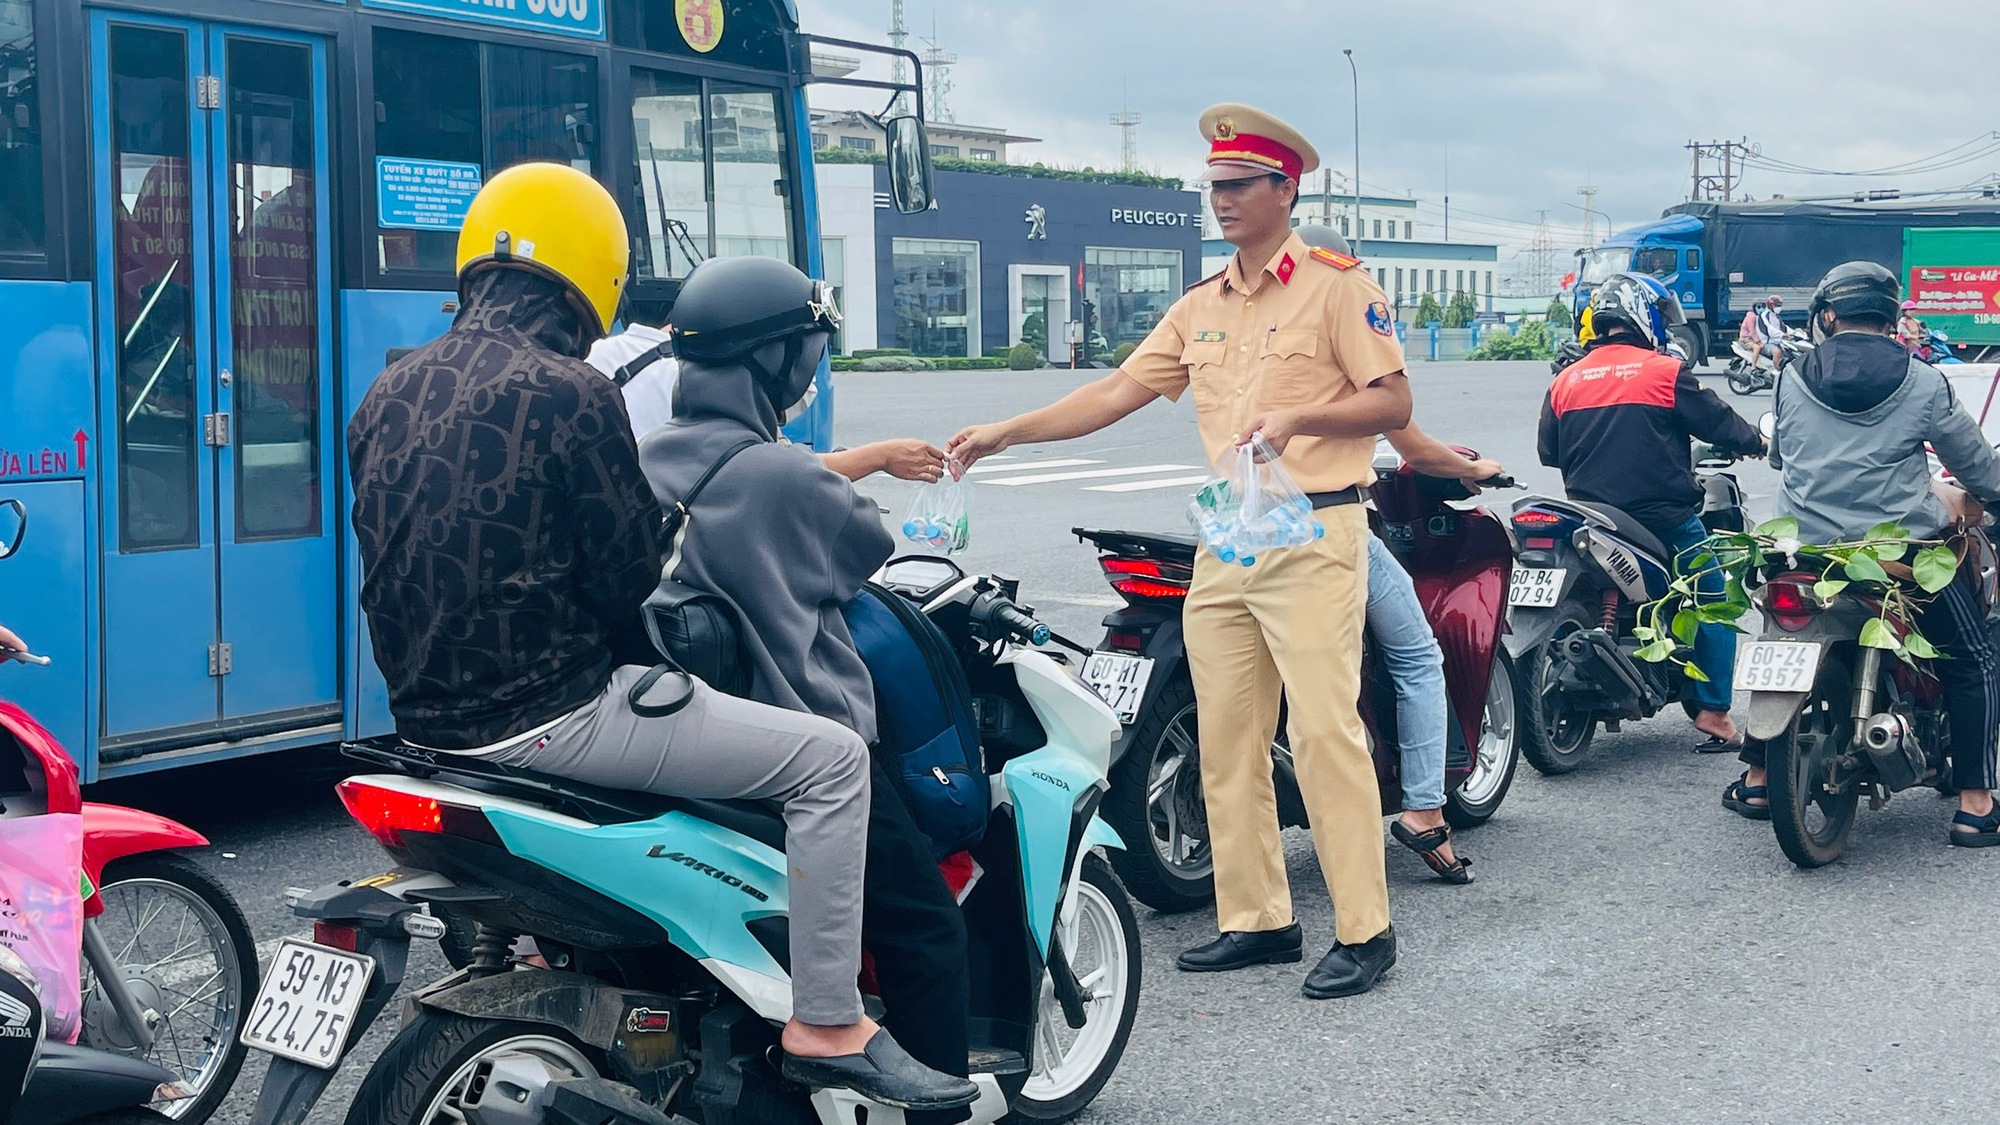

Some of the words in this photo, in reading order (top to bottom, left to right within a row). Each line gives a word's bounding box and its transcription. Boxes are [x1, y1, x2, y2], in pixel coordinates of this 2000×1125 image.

[1111, 208, 1188, 227] PEUGEOT
[28, 447, 67, 475] LÊN
[1511, 569, 1554, 586] 60-B4
[1606, 547, 1640, 587] YAMAHA
[1091, 656, 1141, 684] 60-H1
[1751, 646, 1807, 667] 60-Z4
[1746, 667, 1804, 688] 5957
[1031, 769, 1071, 792] HONDA
[646, 844, 743, 888] VARIO
[279, 950, 355, 1006] 59-N3
[250, 996, 346, 1058] 224.75
